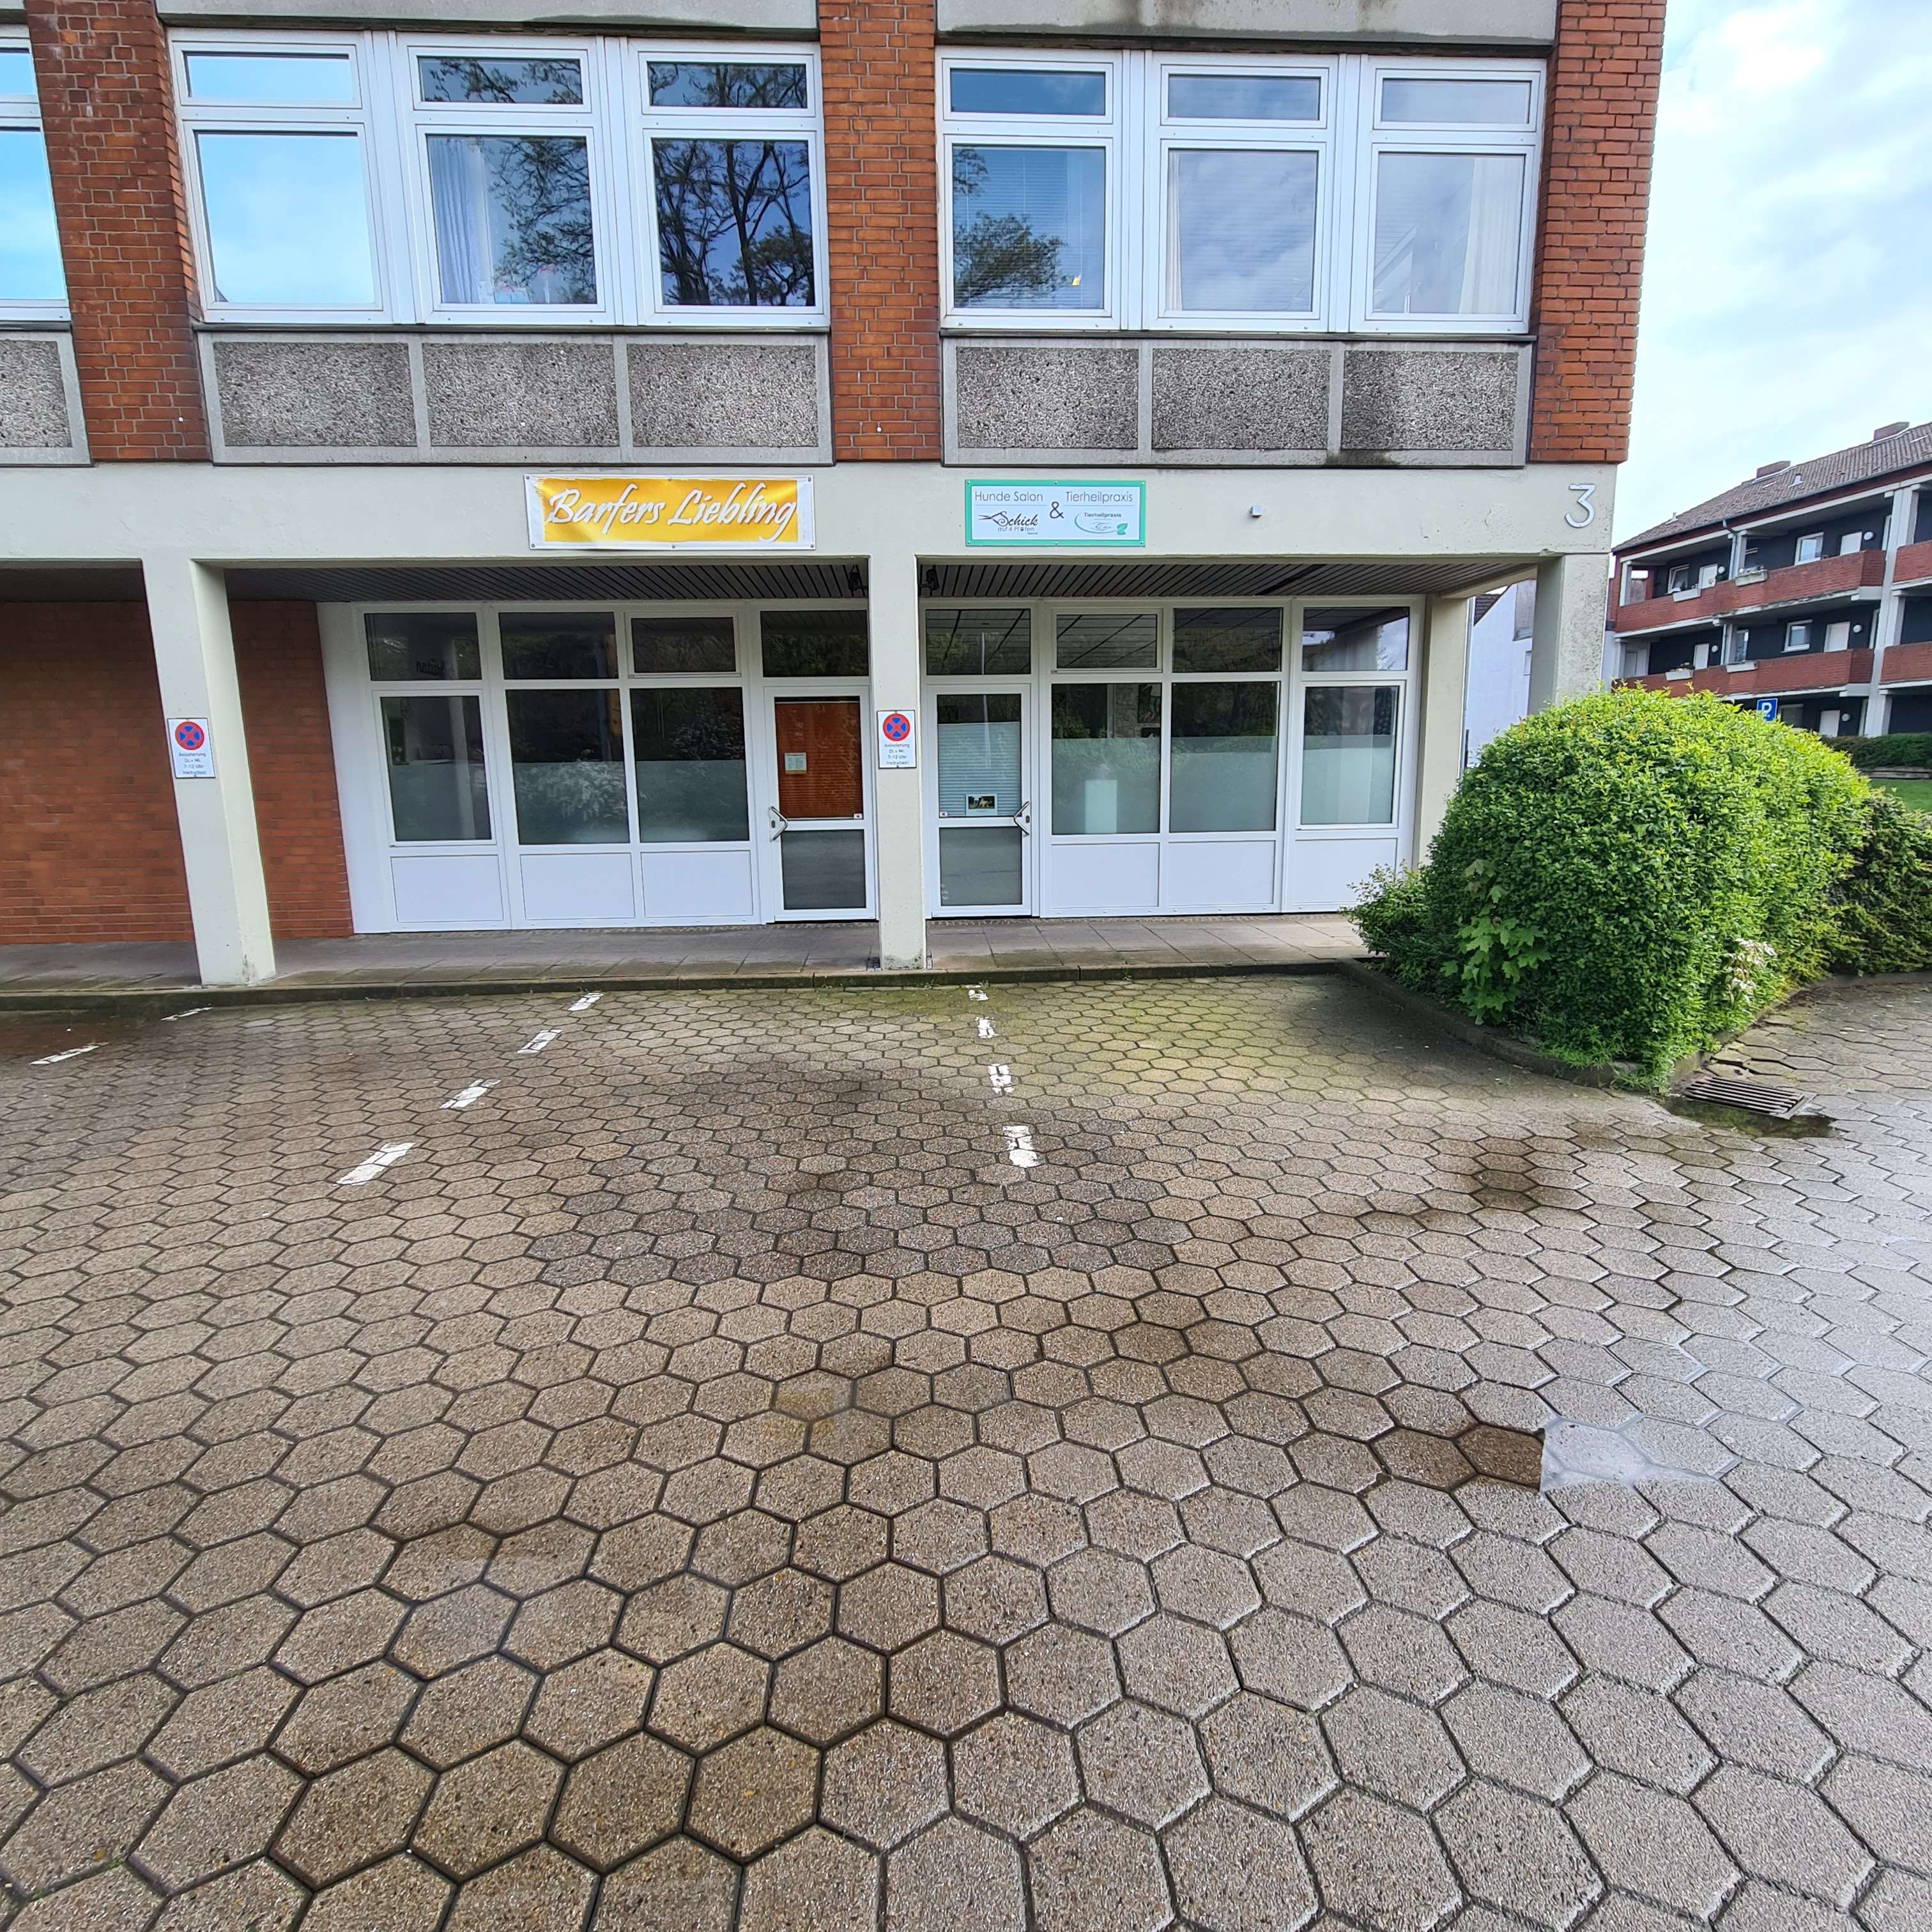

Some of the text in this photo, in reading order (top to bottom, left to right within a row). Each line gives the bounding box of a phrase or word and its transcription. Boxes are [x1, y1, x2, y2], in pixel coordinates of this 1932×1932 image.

[975, 491, 1043, 502] Hunde Salon
[1065, 491, 1133, 504] Tierheilpraxis
[548, 482, 797, 542] Barfers Liebling
[1049, 501, 1064, 519] &
[1564, 483, 1595, 528] 3
[992, 510, 1038, 526] Schick
